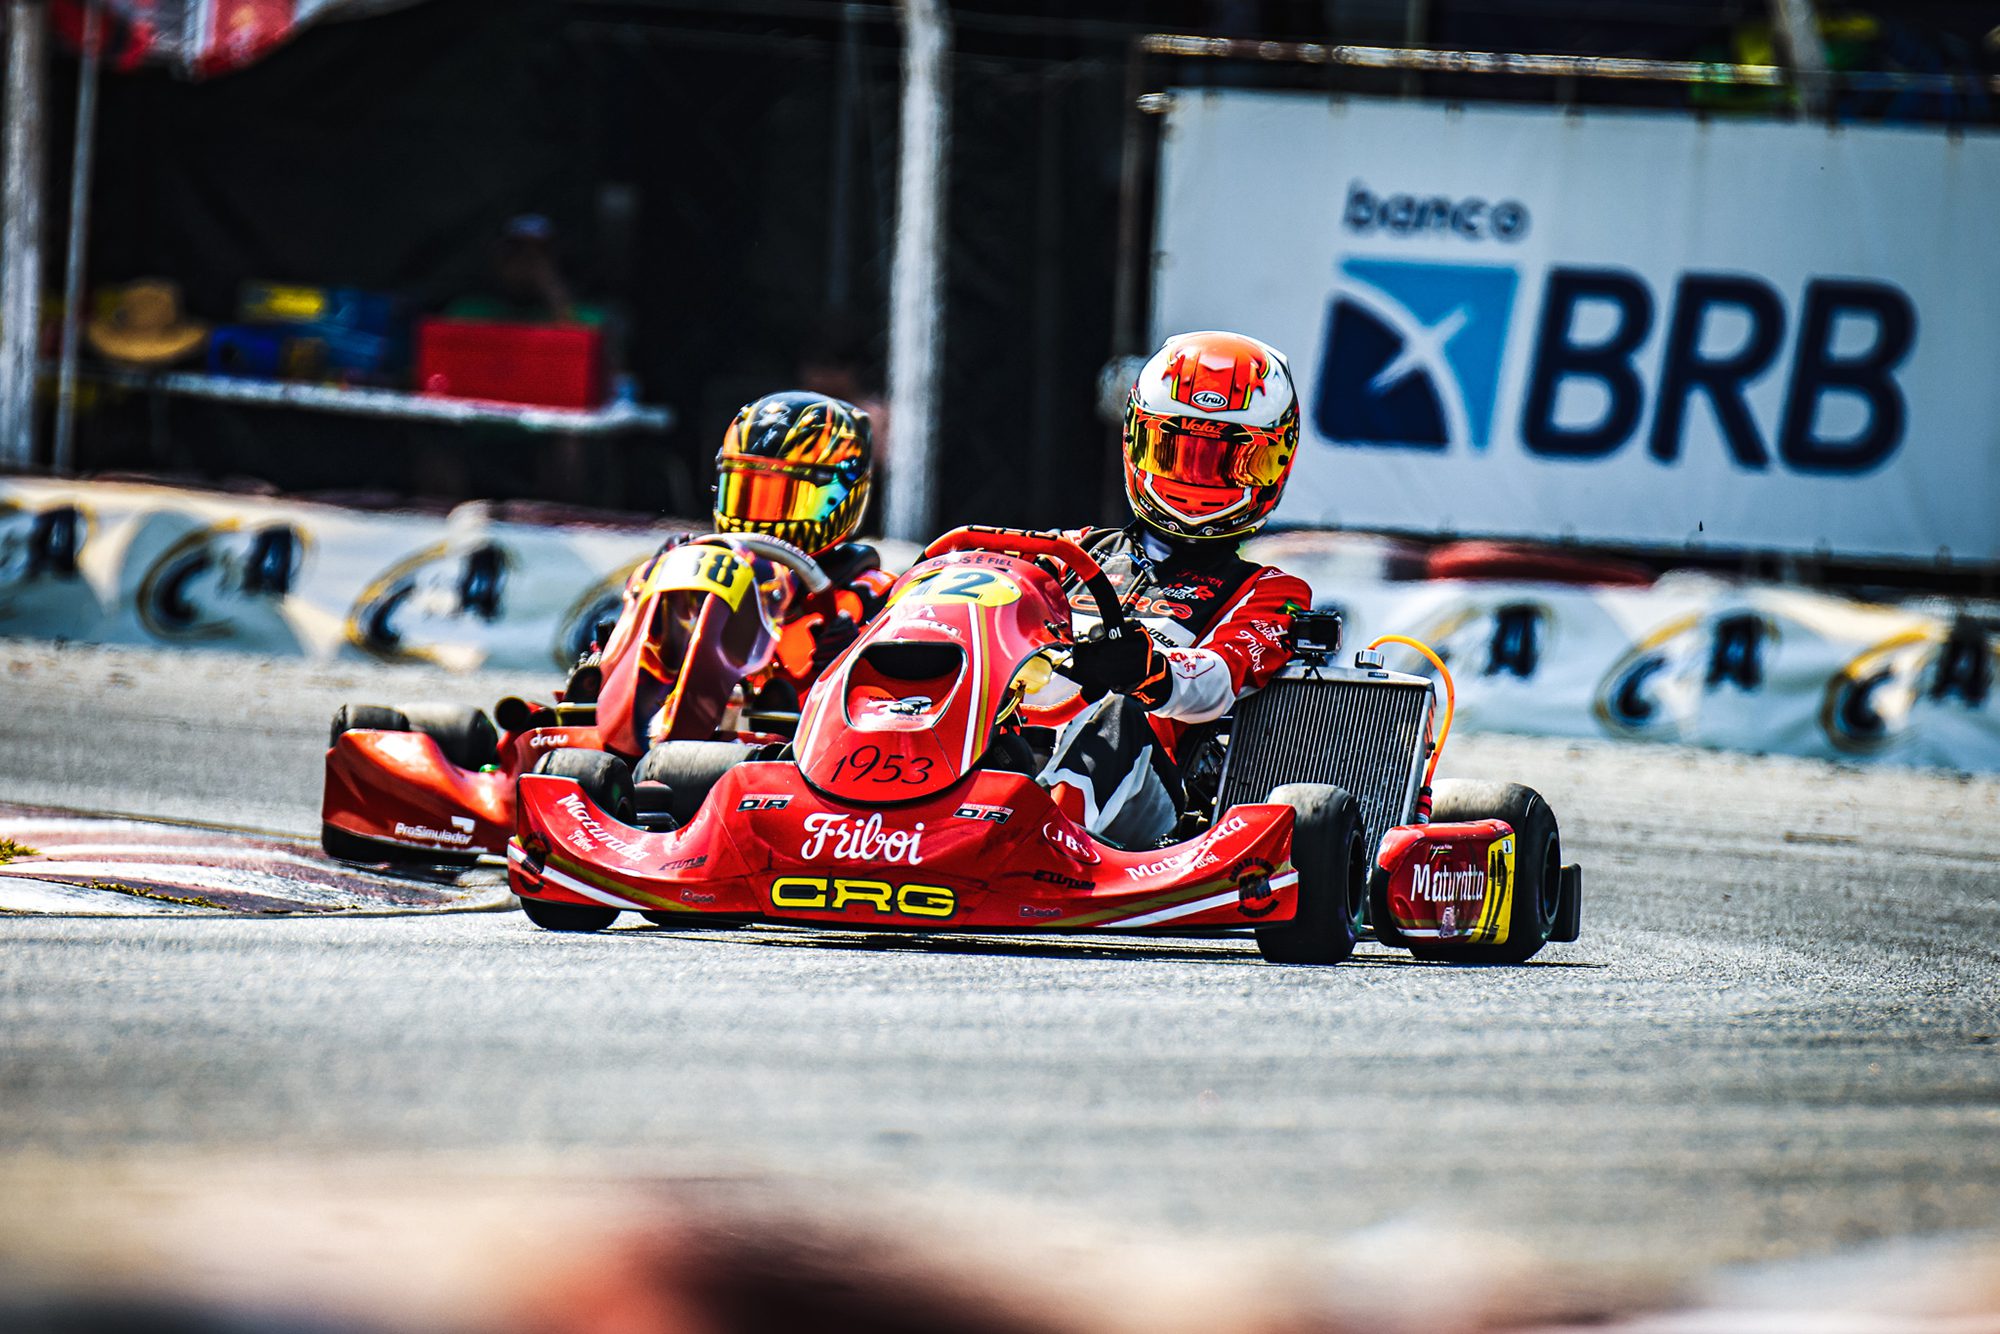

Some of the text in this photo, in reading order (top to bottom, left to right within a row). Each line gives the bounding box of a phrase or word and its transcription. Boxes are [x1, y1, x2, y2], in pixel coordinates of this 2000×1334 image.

[1343, 178, 1530, 243] banco
[1521, 264, 1918, 476] BRB
[1196, 392, 1222, 406] Arai
[987, 557, 1014, 567] FIEL
[830, 744, 934, 785] 1953
[394, 822, 473, 845] ProSimulador
[801, 812, 925, 865] Friboi
[771, 876, 956, 917] CRG
[1410, 864, 1485, 902] Maturatta
